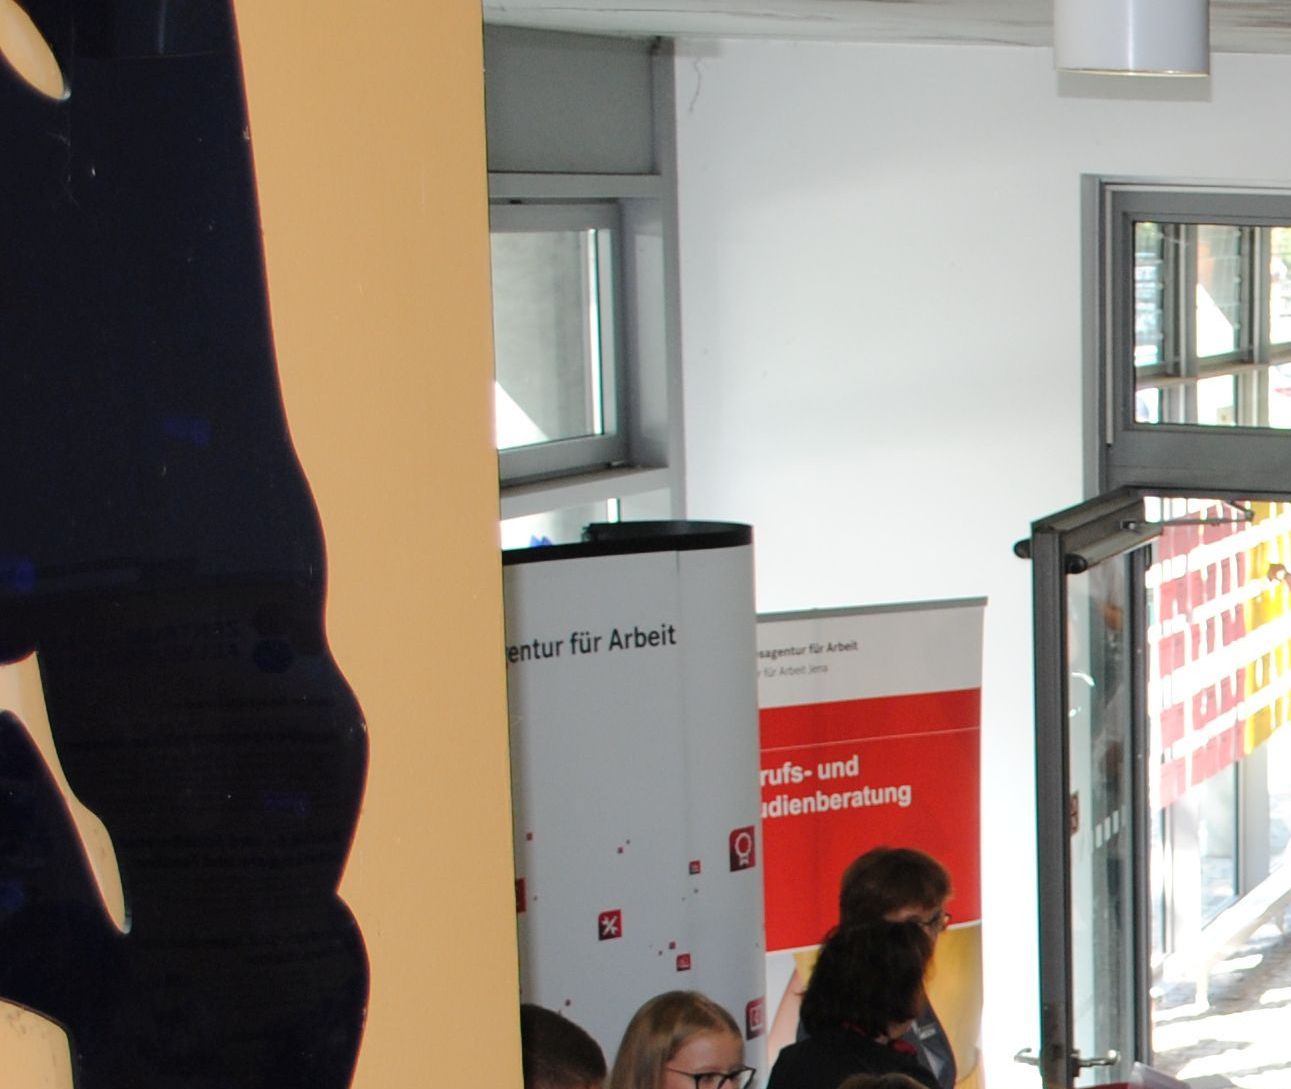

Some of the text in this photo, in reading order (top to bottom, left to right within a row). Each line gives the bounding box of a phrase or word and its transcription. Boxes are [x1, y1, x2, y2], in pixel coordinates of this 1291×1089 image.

[505, 624, 677, 664] entur für Arbeit
[808, 643, 824, 654] für
[826, 641, 859, 653] Arbeit
[760, 754, 860, 787] rufs- und
